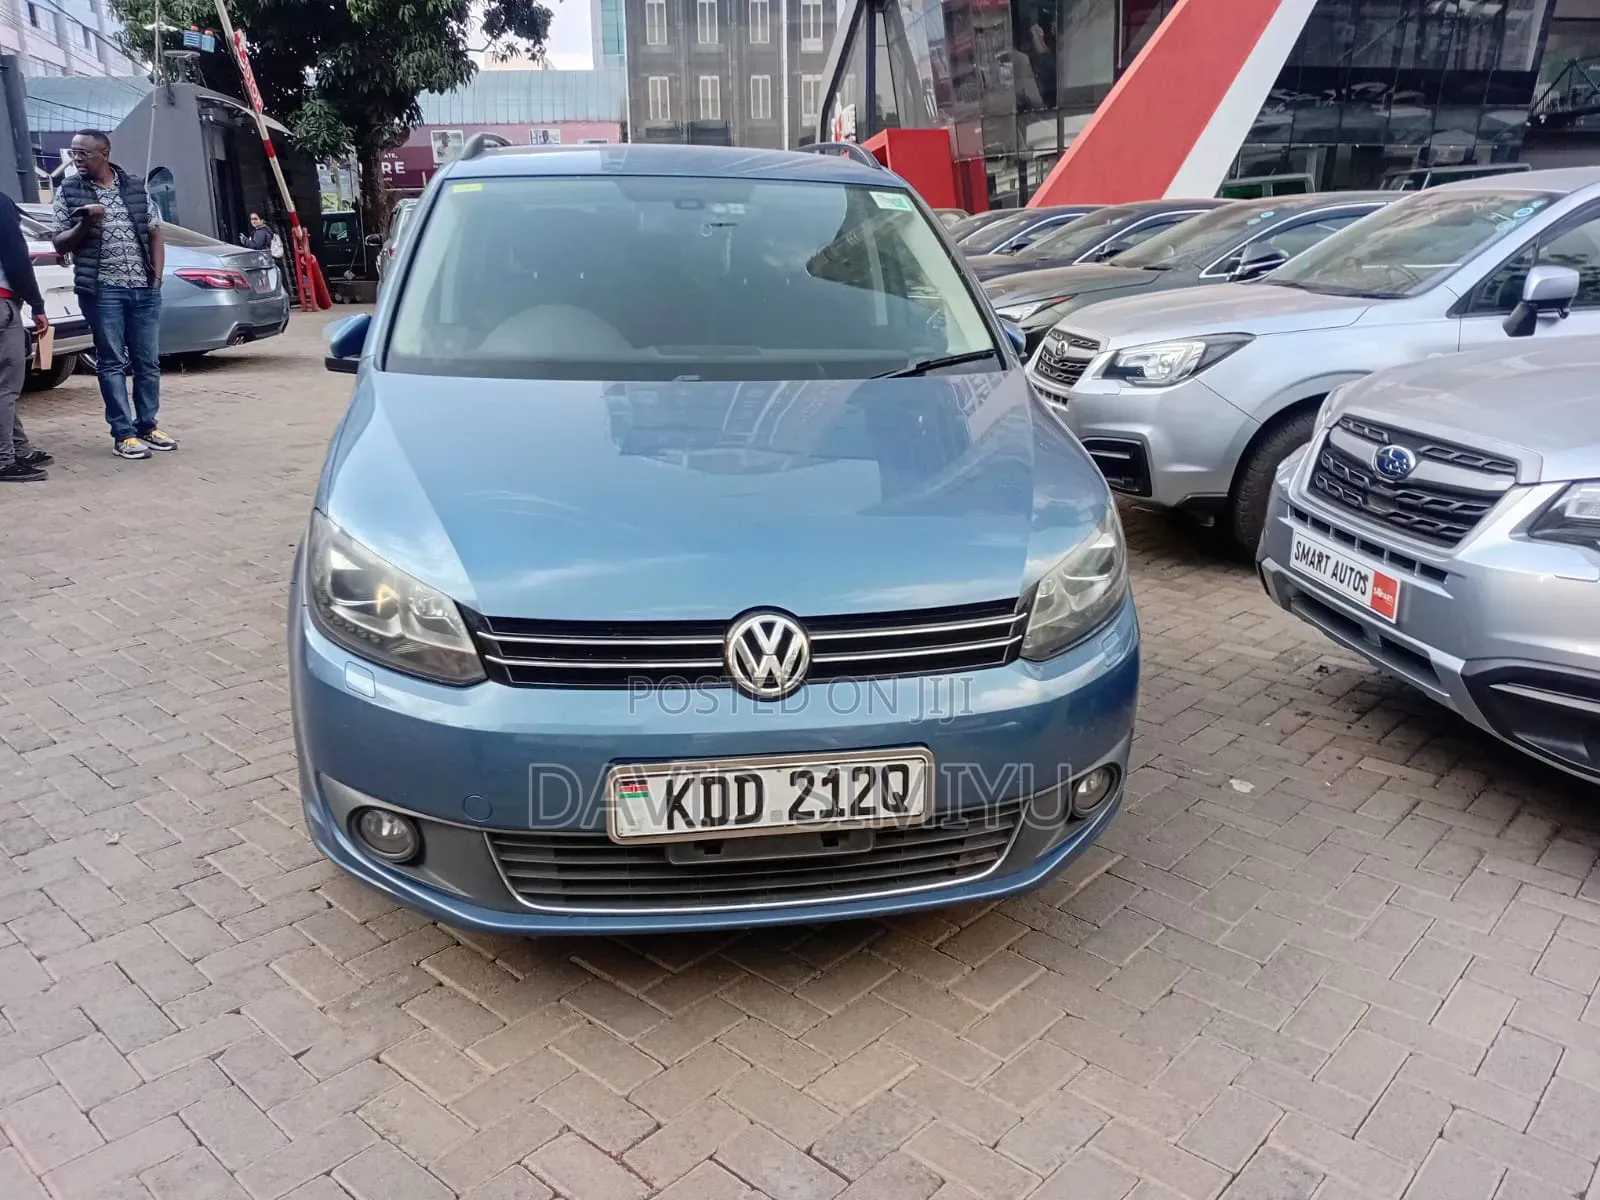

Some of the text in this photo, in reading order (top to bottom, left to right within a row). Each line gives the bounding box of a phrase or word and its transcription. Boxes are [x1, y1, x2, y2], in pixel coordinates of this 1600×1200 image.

[1294, 540, 1369, 596] SMART AUTOS
[666, 763, 911, 831] KDD 212Q
